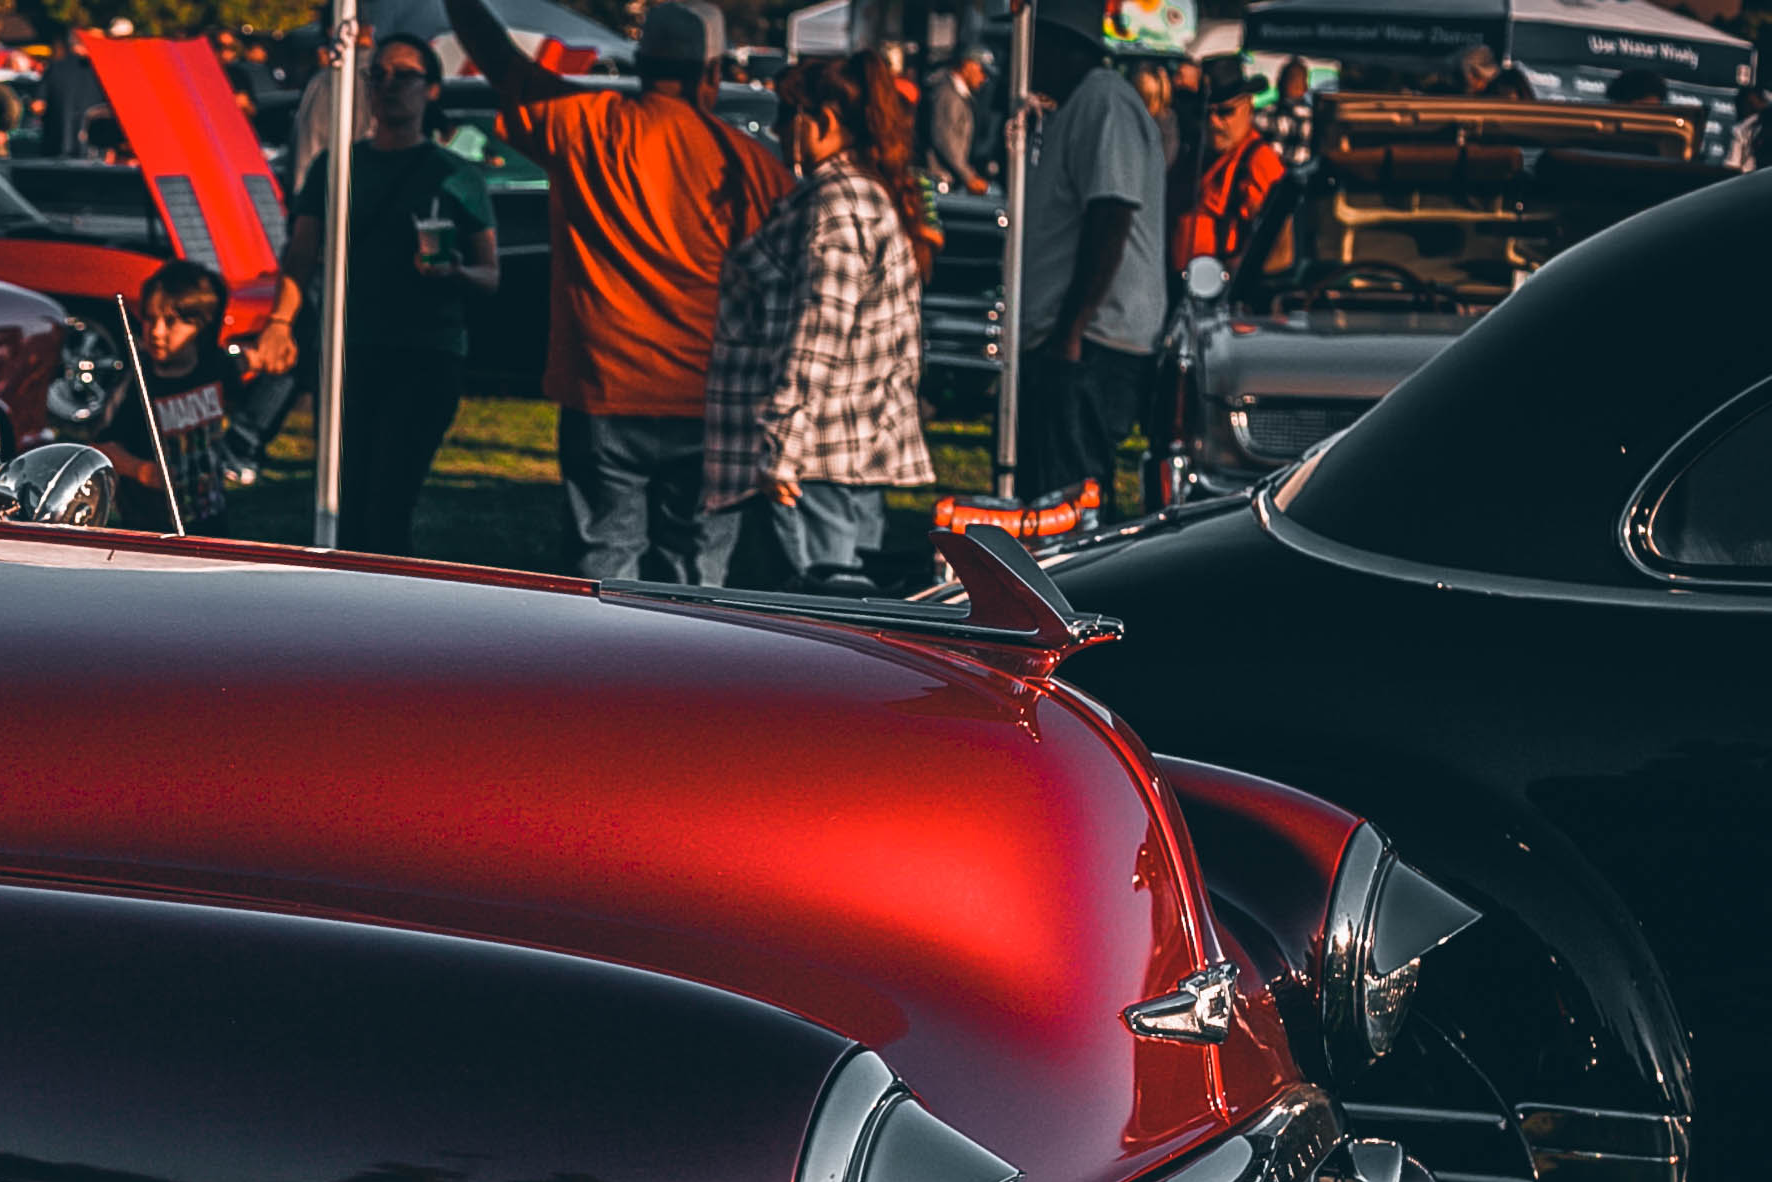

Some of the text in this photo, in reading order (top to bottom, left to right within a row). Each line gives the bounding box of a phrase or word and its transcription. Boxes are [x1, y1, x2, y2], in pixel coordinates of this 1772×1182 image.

[1588, 34, 1699, 71] Use Water Wisely
